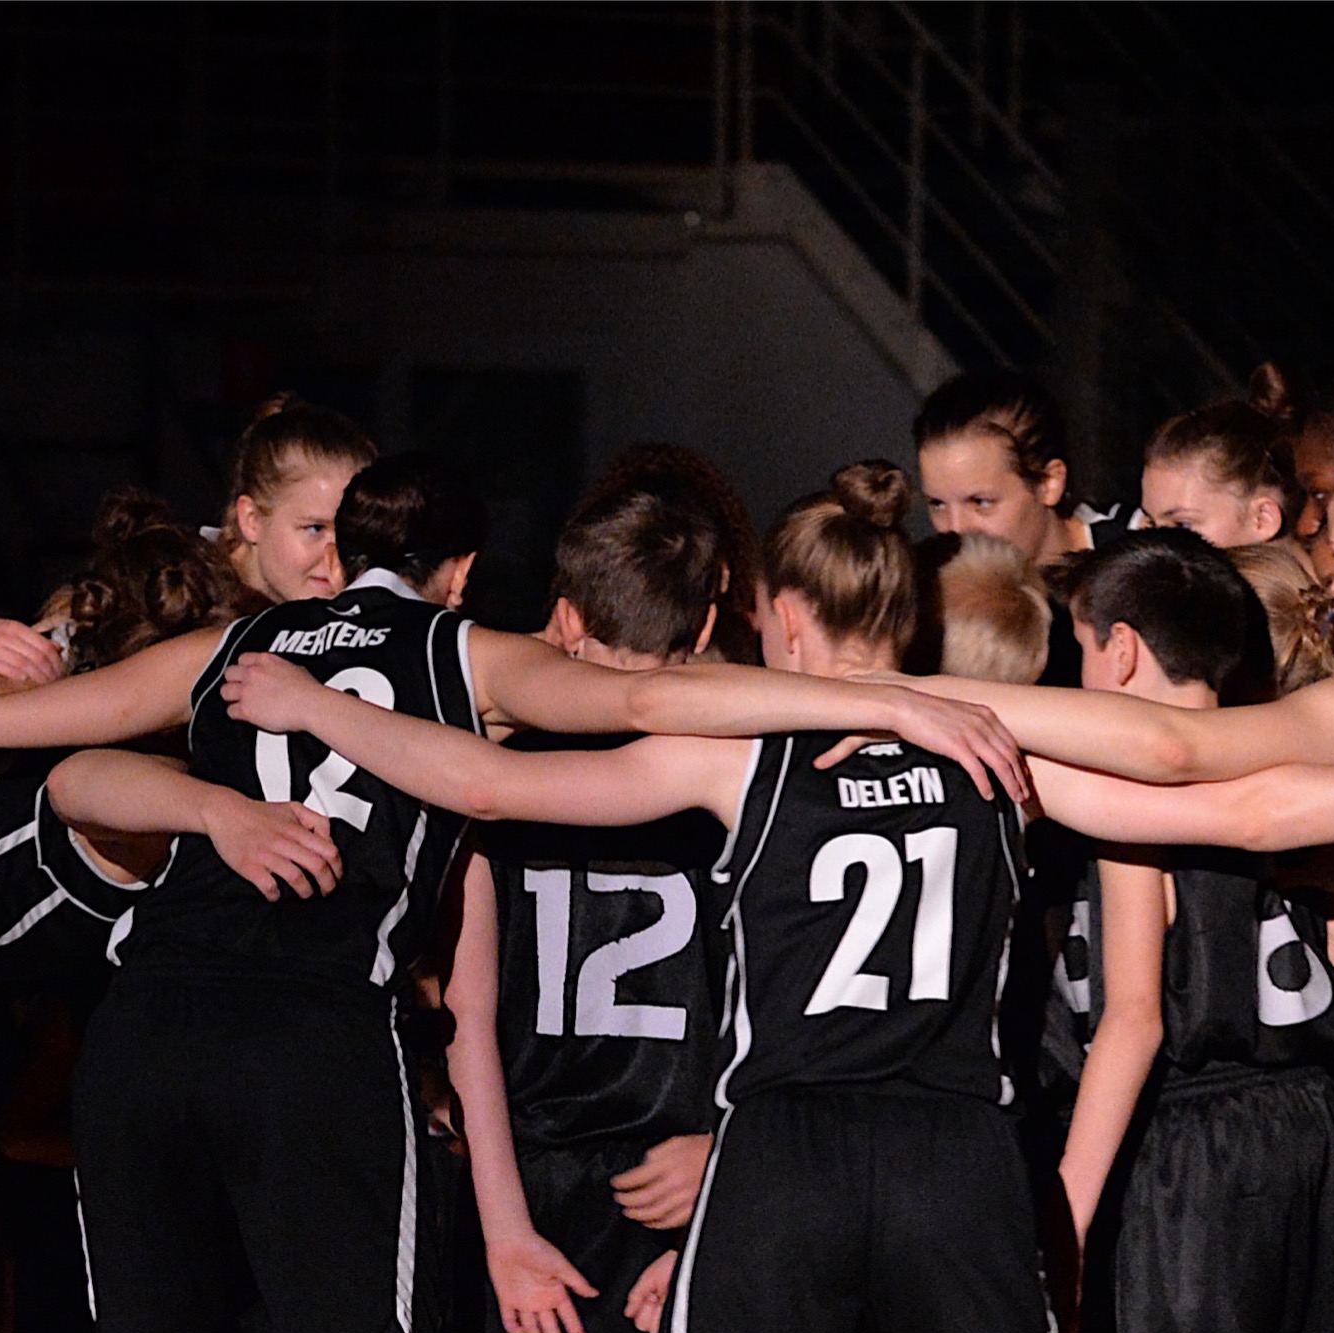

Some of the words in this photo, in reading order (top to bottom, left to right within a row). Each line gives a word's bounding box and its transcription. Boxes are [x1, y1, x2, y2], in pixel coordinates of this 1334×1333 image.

[268, 620, 391, 656] MERTENS
[836, 766, 946, 809] DELEYN
[523, 868, 698, 1041] 12
[803, 826, 959, 1017] 21
